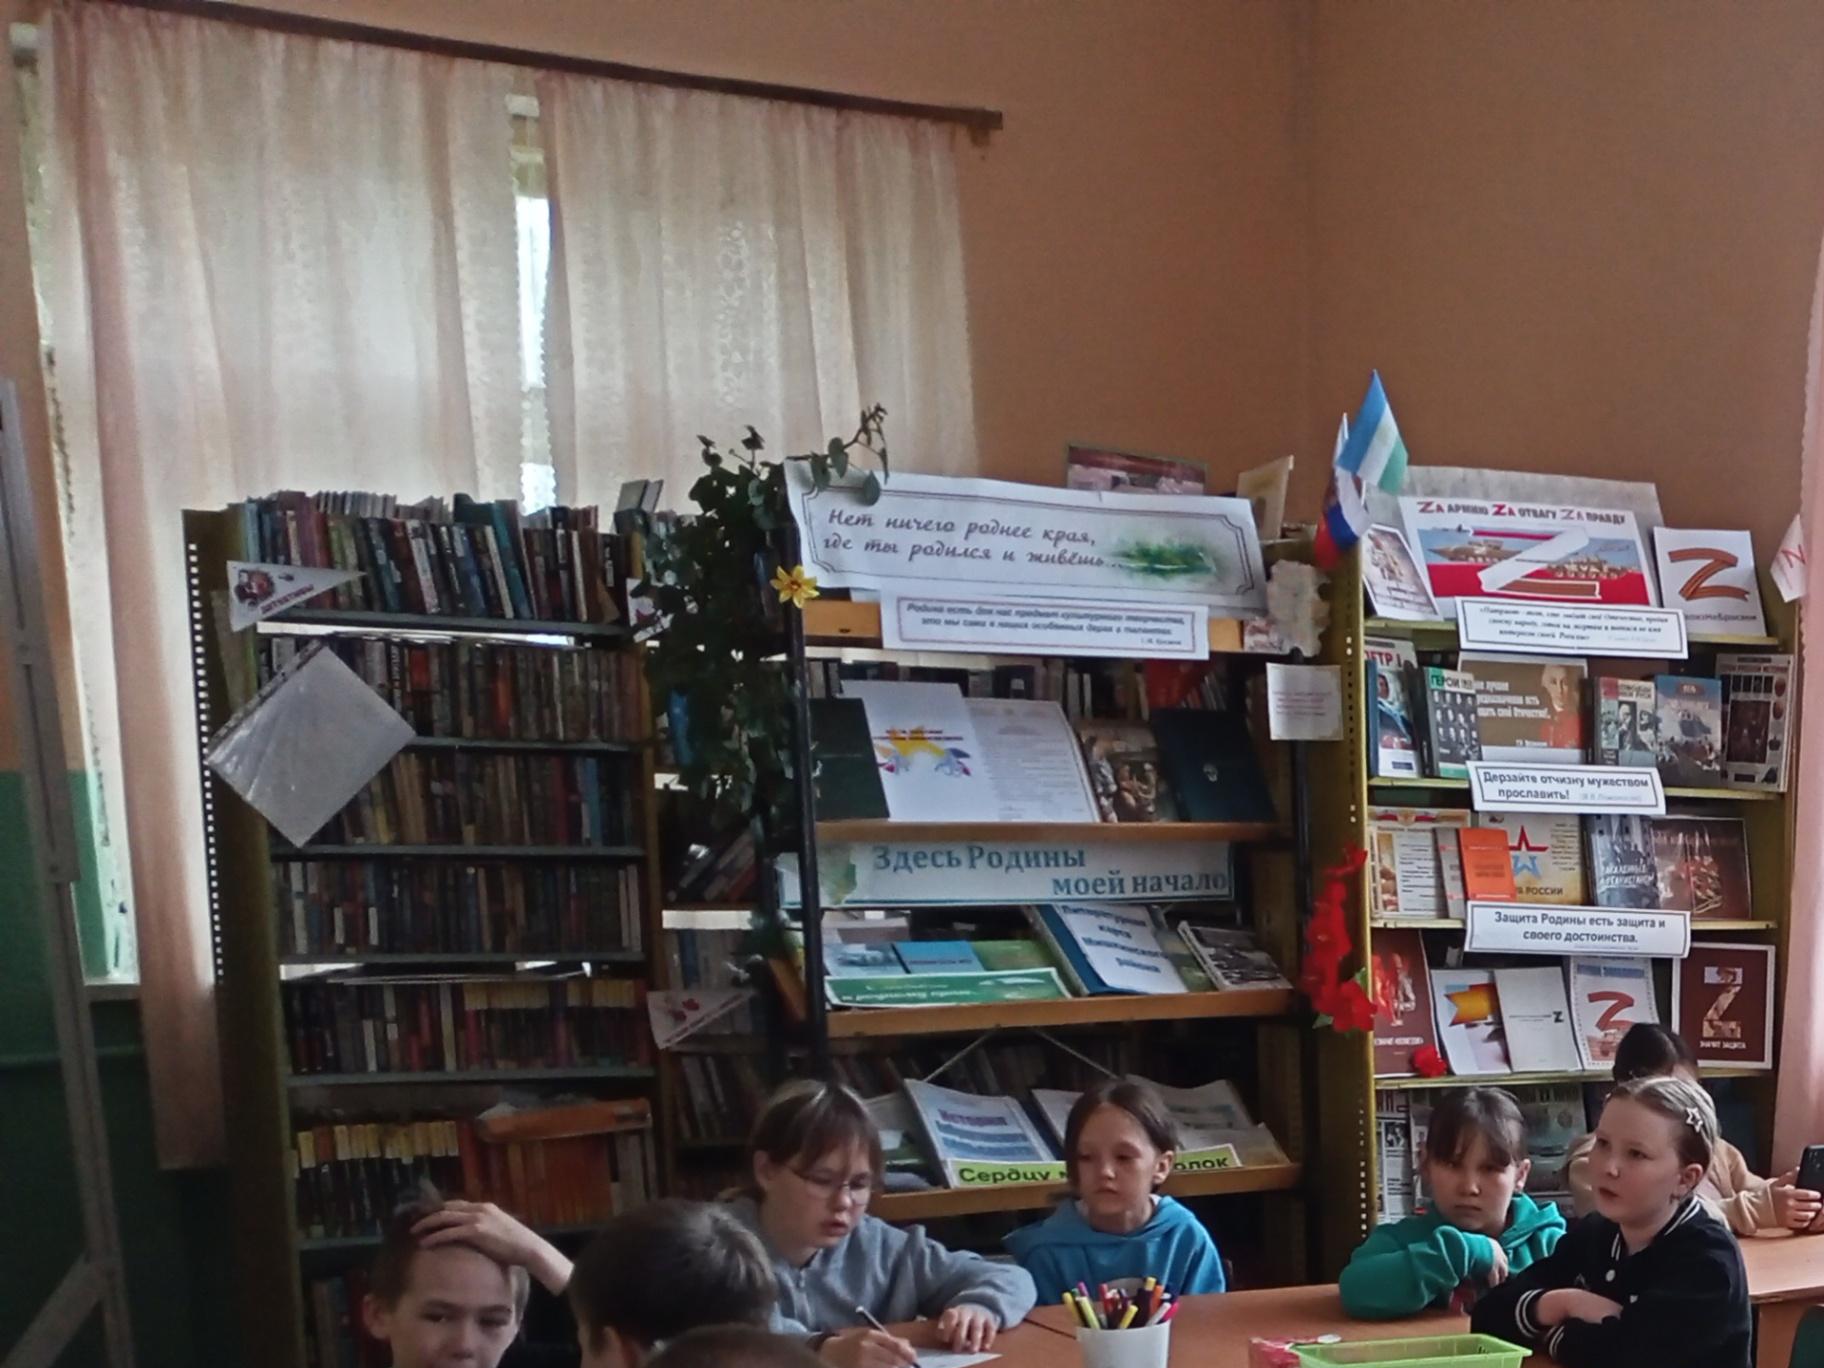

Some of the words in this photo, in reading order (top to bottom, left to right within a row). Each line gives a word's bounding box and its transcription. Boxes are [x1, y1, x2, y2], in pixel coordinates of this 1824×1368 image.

[828, 508, 873, 528] Нет
[885, 515, 956, 533] ничего
[964, 519, 1033, 541] роднее
[1042, 527, 1097, 549] края,
[823, 532, 854, 552] где
[865, 539, 899, 555] ты
[908, 540, 992, 562] родился
[1003, 549, 1016, 562] и
[1668, 547, 1751, 601] Z
[1484, 771, 1538, 784] Дерзайте
[1540, 775, 1585, 787] отчизну
[1587, 777, 1649, 790] мужеством
[1498, 788, 1570, 801] прославить!
[873, 846, 962, 874] Здесь
[968, 845, 1087, 873] Родины
[1051, 869, 1125, 897] моей
[1526, 886, 1564, 896] РОССИИ
[1494, 911, 1538, 925] Защита
[1541, 914, 1586, 927] Родины
[1589, 917, 1614, 927] есть
[1617, 919, 1656, 929] защита
[1658, 920, 1666, 928] и
[1523, 929, 1562, 941] своего
[1564, 931, 1638, 943] достоинства.
[1701, 966, 1744, 1039] Z
